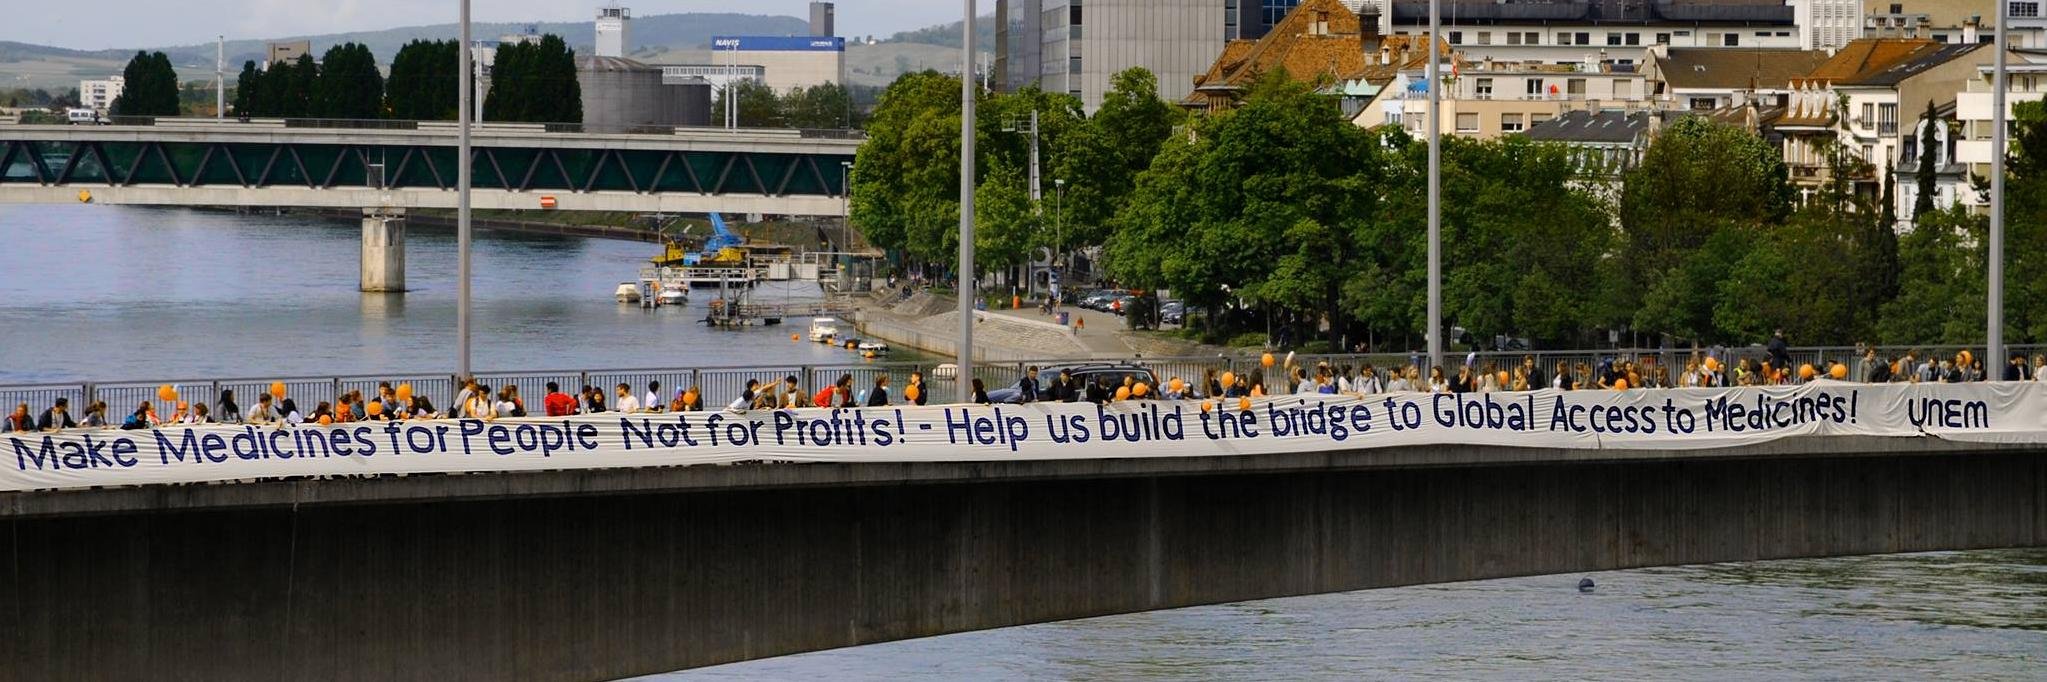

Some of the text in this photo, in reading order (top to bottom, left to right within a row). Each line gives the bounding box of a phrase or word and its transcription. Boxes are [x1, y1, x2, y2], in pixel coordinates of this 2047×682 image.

[13, 389, 1858, 470] Make Medicines for People Not for Profits! - Help us build the bridge to Global Access to Medicines!
